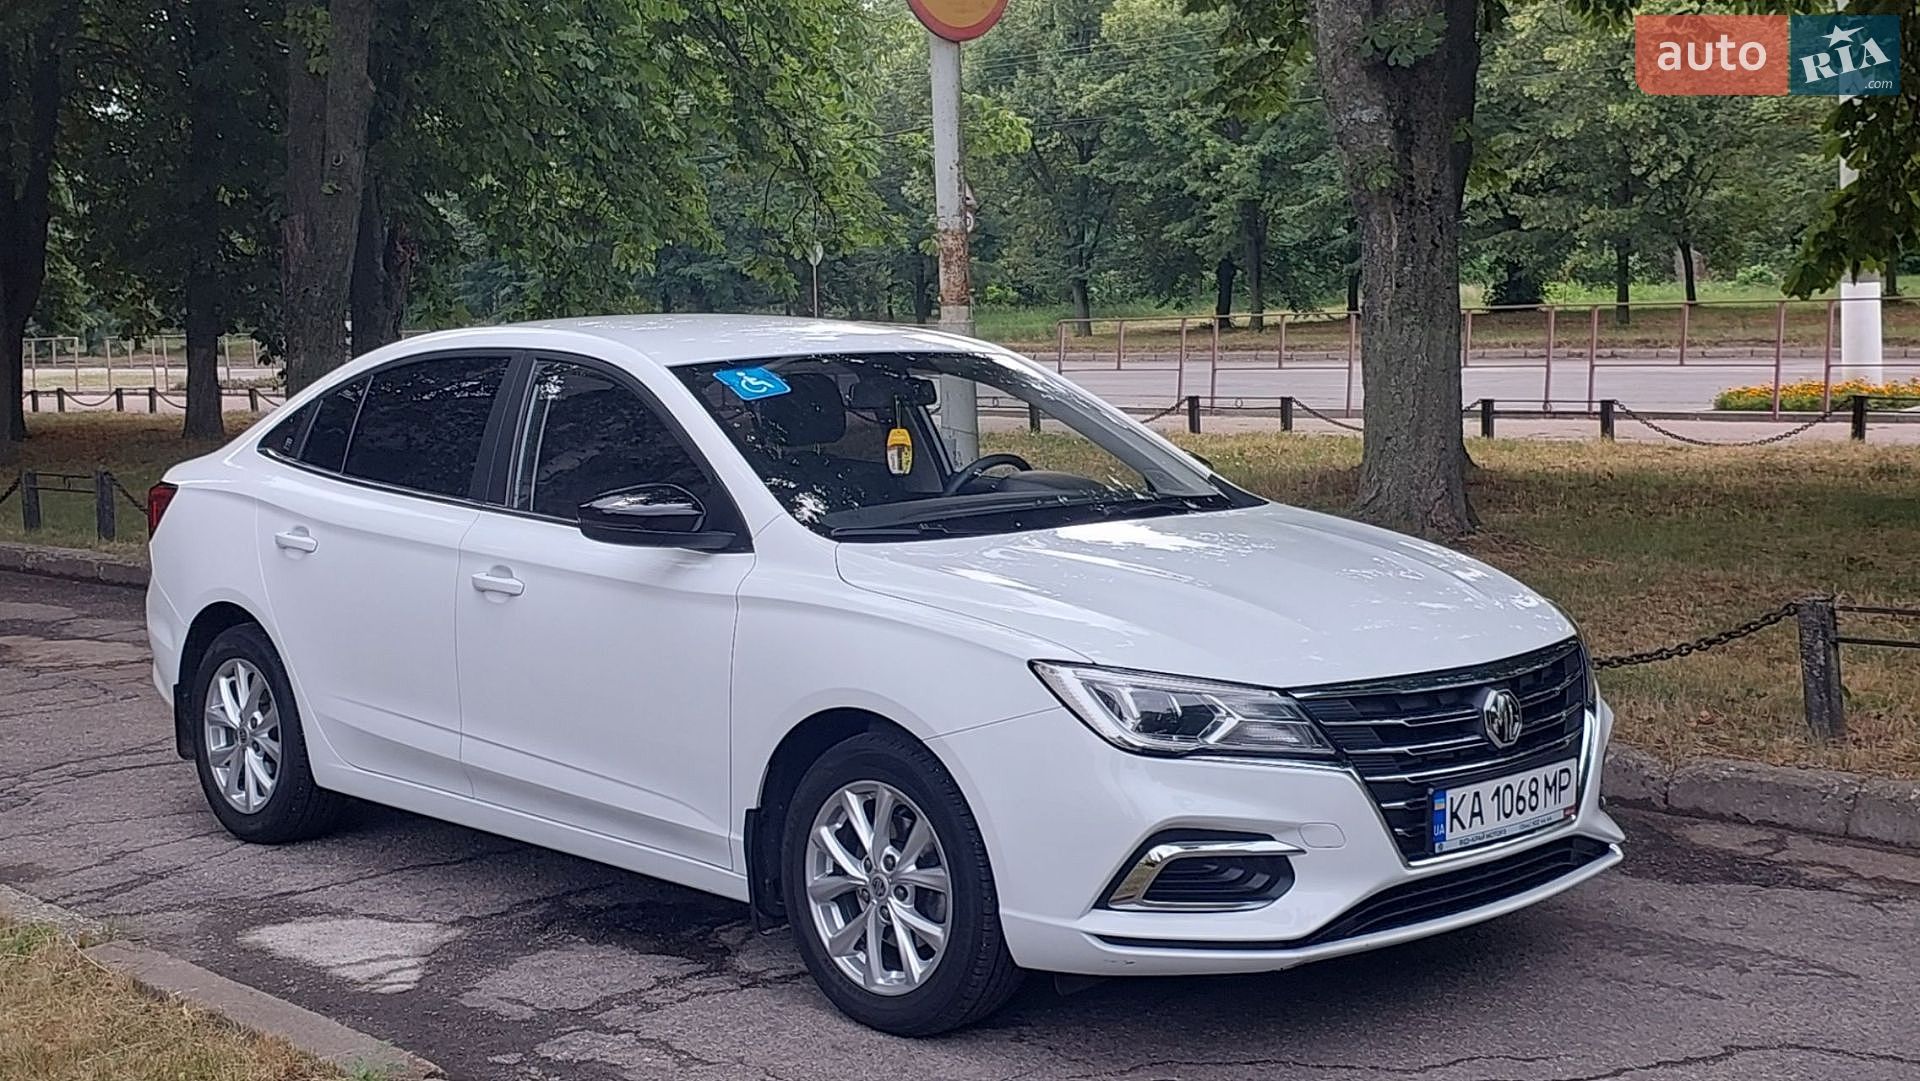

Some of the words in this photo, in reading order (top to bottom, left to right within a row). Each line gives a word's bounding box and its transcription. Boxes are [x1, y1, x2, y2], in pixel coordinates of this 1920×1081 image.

[1488, 693, 1520, 742] MG
[1450, 790, 1485, 833] KA
[1490, 776, 1540, 822] 1068
[1543, 767, 1572, 809] MP
[1433, 823, 1446, 837] UA
